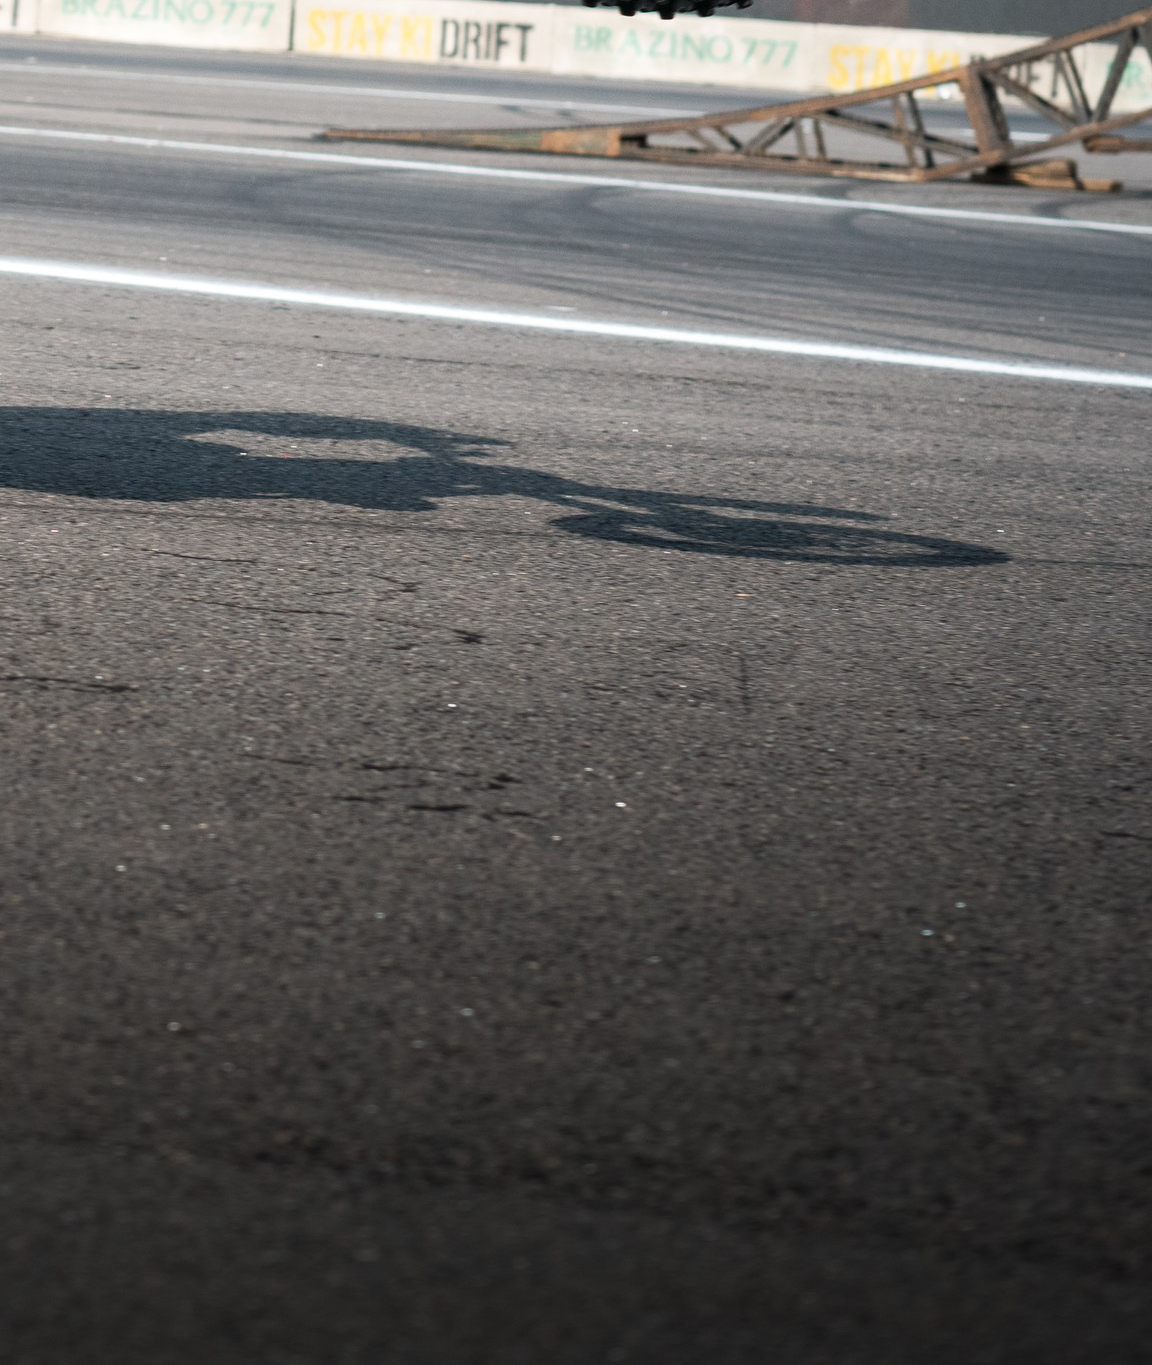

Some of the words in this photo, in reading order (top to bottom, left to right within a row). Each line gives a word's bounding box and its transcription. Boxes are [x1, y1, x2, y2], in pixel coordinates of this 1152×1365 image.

[306, 7, 394, 58] STAY
[439, 18, 535, 64] DRIFT
[572, 23, 735, 65] BRAZINO
[739, 35, 799, 70] 777
